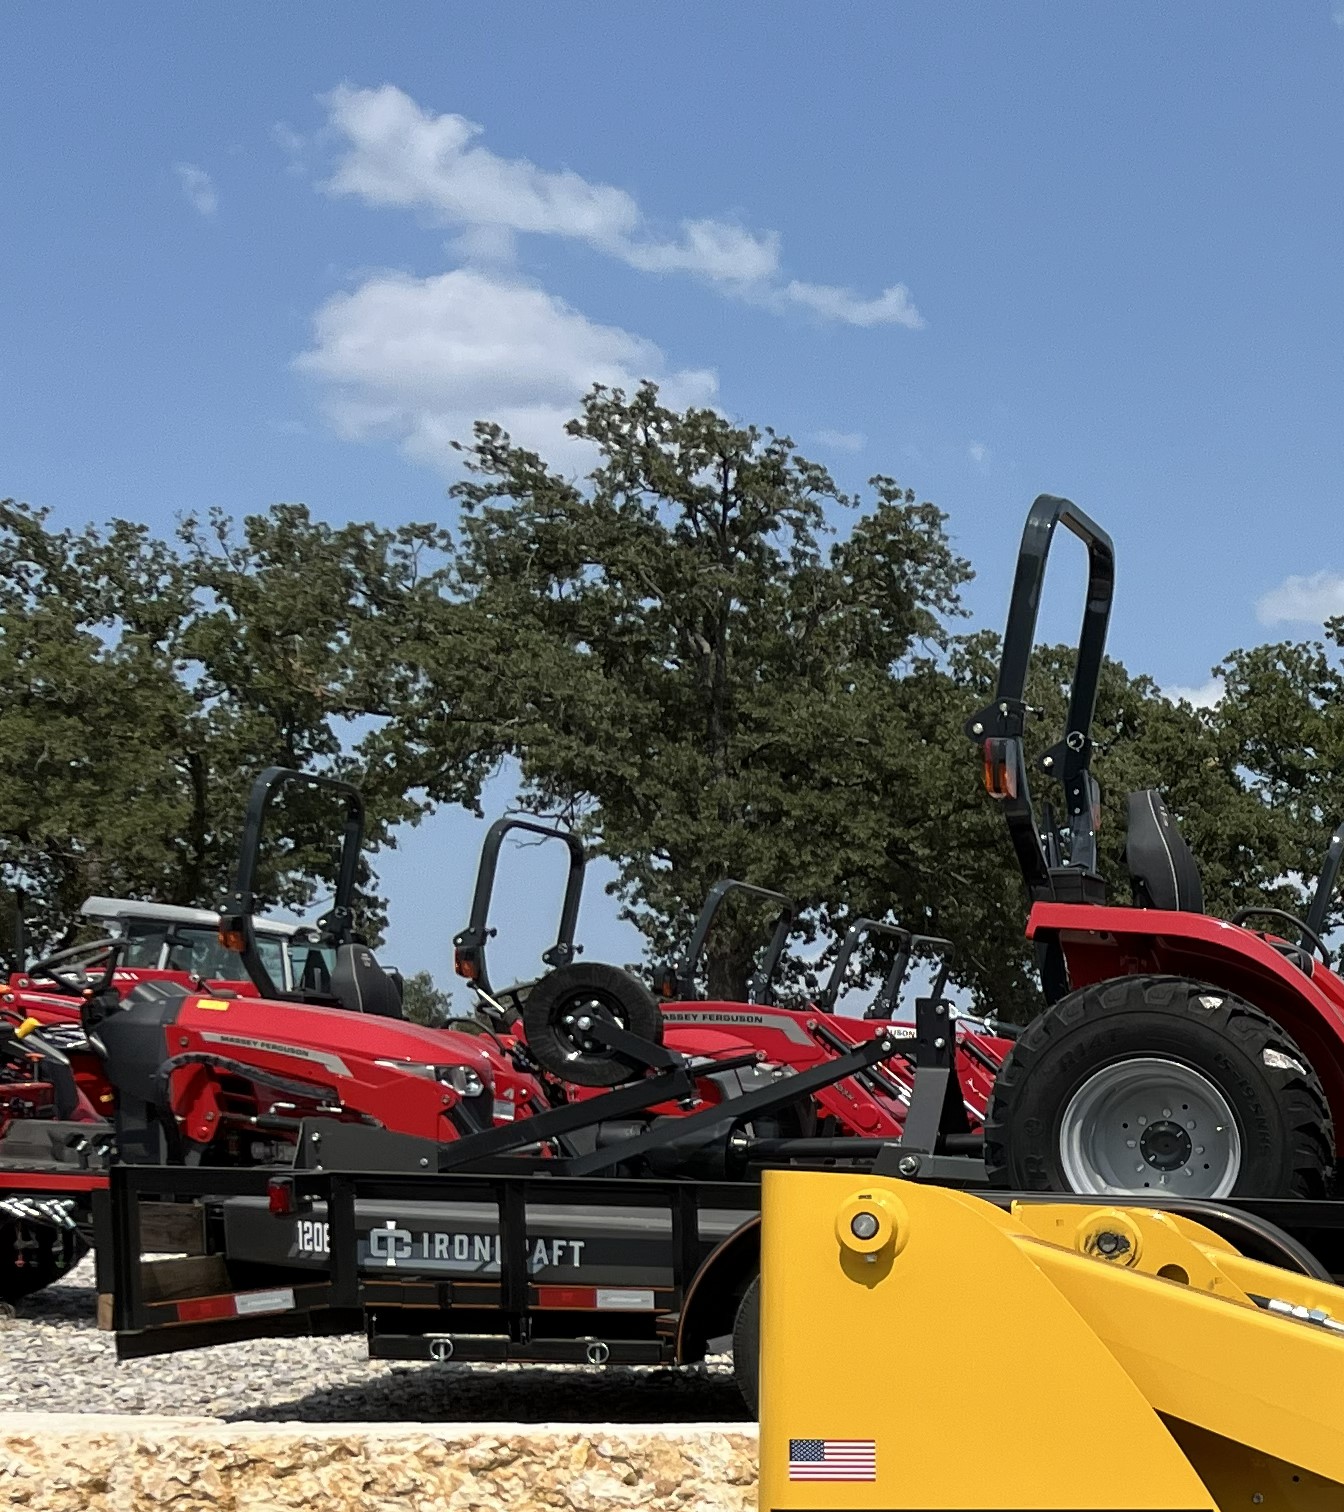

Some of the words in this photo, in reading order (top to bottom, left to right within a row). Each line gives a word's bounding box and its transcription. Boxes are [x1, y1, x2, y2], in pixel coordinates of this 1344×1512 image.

[702, 1013, 763, 1023] FERGUSON
[221, 1035, 258, 1047] MASSEY
[260, 1041, 309, 1057] FERGUSON
